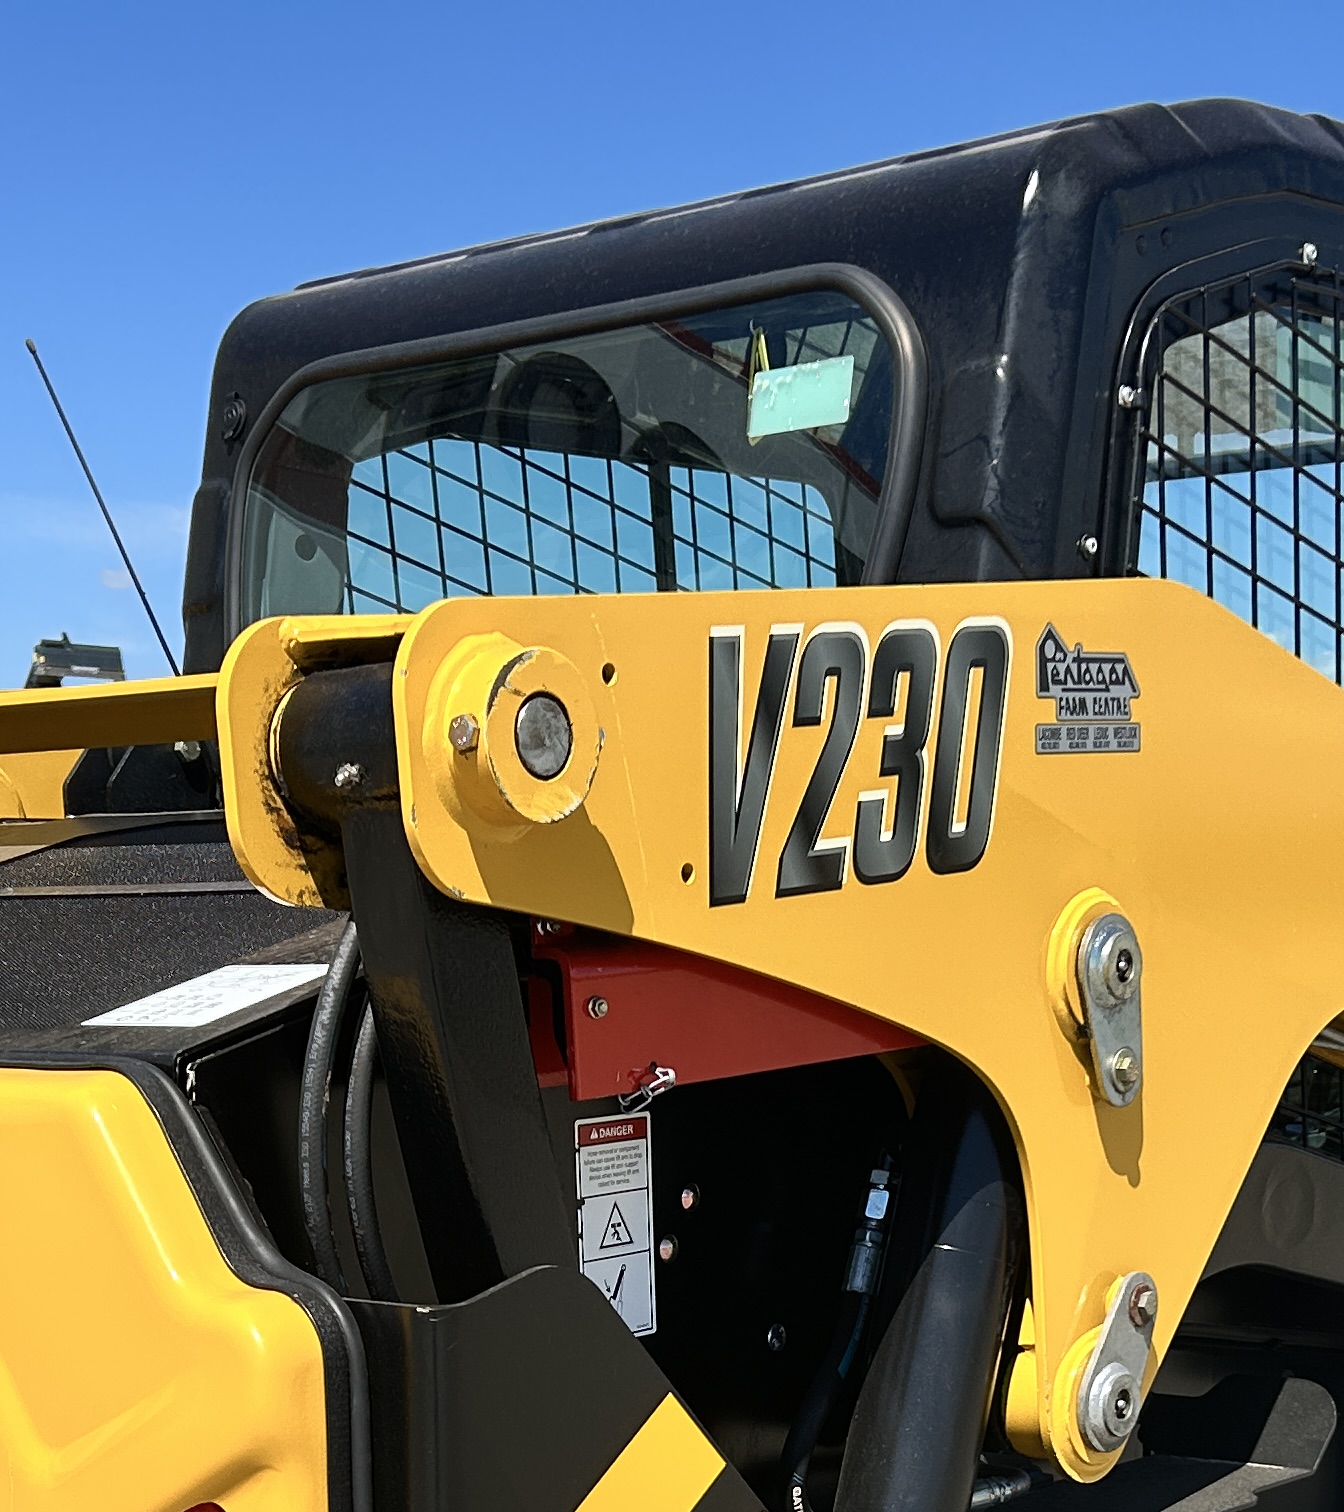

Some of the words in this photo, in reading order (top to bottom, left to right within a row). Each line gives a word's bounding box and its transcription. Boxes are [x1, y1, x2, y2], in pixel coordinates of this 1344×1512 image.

[1039, 628, 1137, 693] Pentagon
[1058, 697, 1089, 716] FARM
[1092, 697, 1129, 716] CENTRE
[709, 615, 1013, 908] V230
[599, 1124, 634, 1138] DANGER
